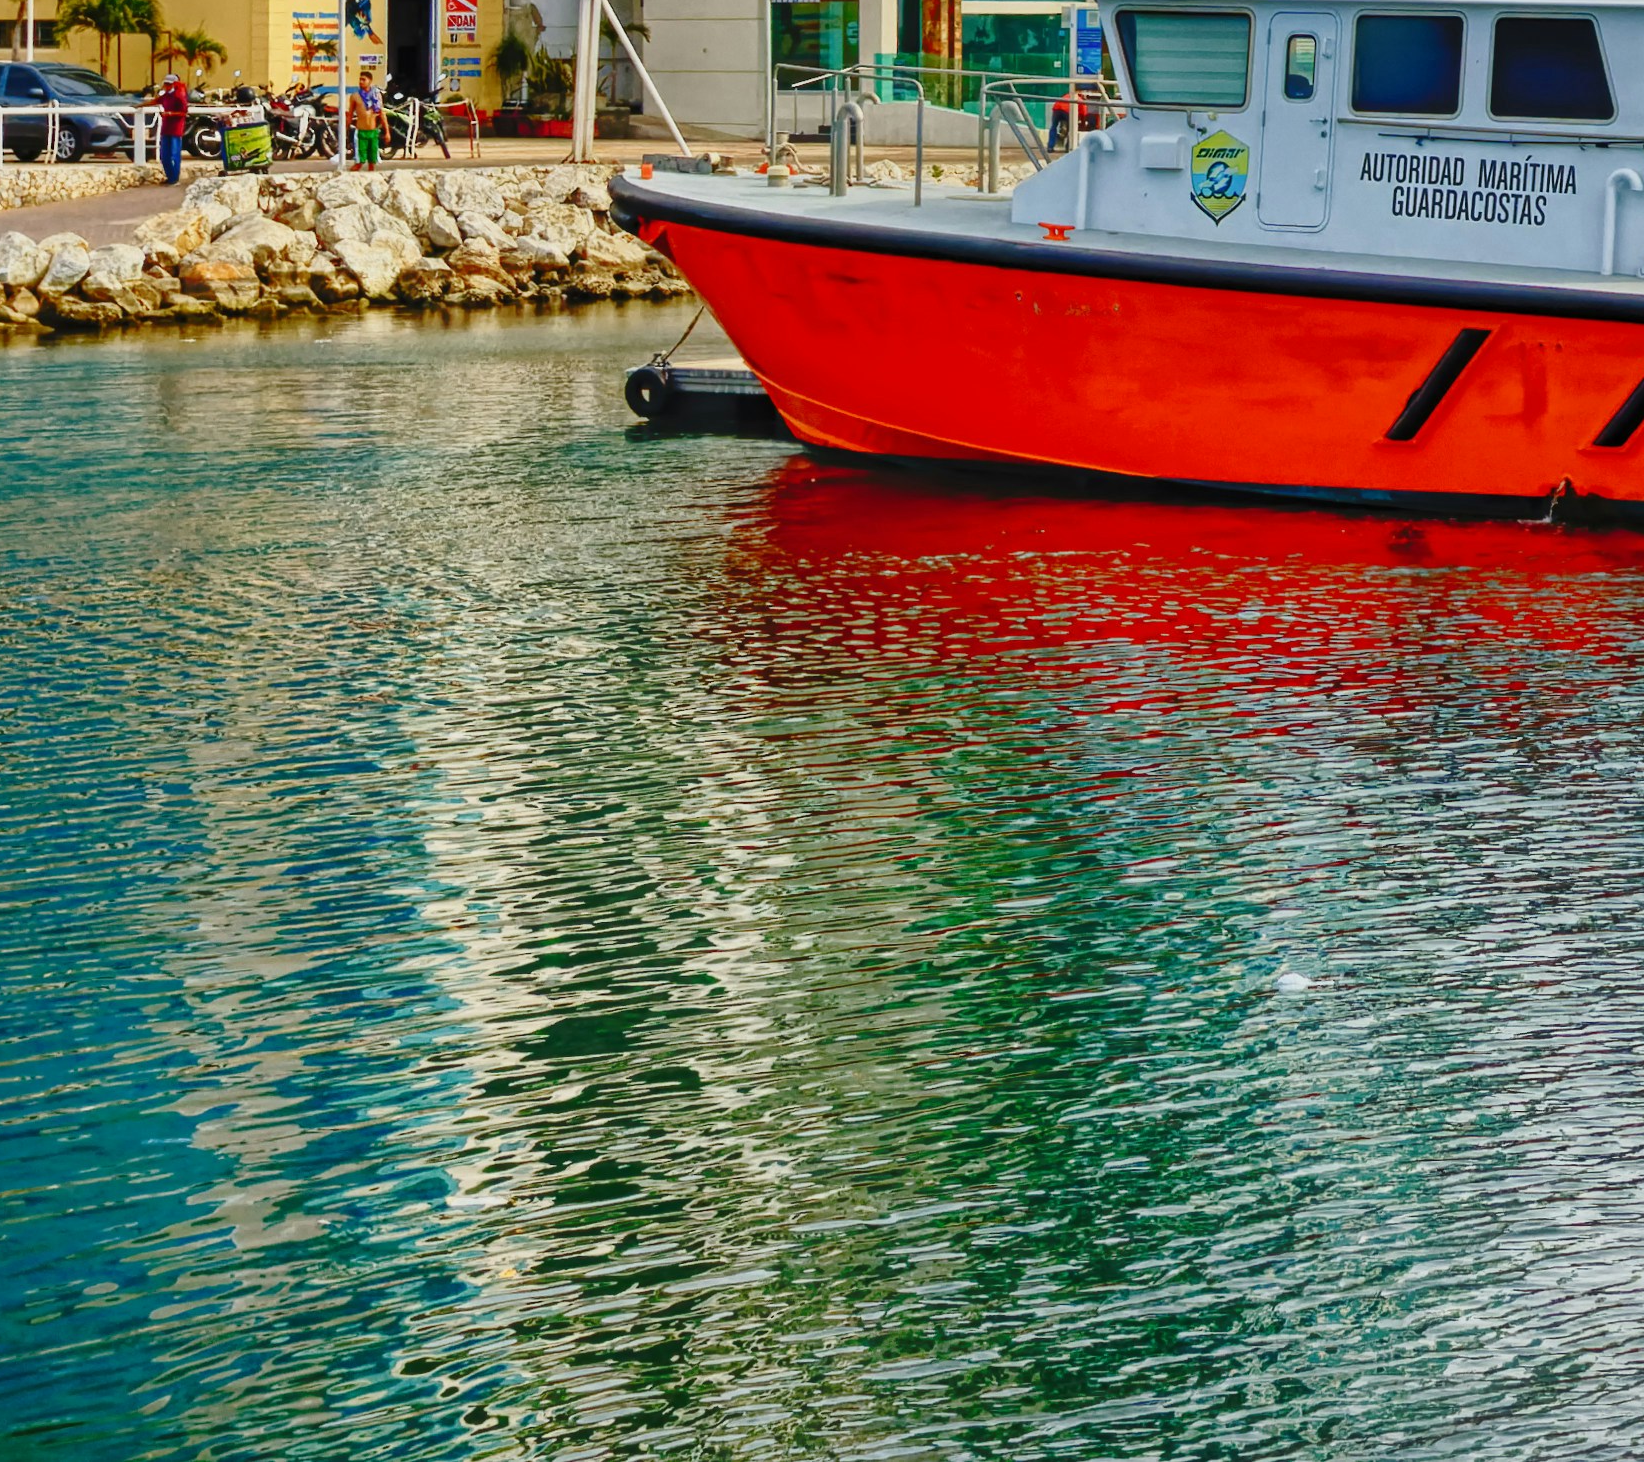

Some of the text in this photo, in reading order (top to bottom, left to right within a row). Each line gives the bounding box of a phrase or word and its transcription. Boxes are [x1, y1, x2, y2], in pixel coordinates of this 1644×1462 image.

[456, 13, 477, 28] DAN
[1360, 152, 1578, 195] AUTORIDAD MARÍTIMA
[1391, 185, 1548, 227] GUARDACOSTAS
